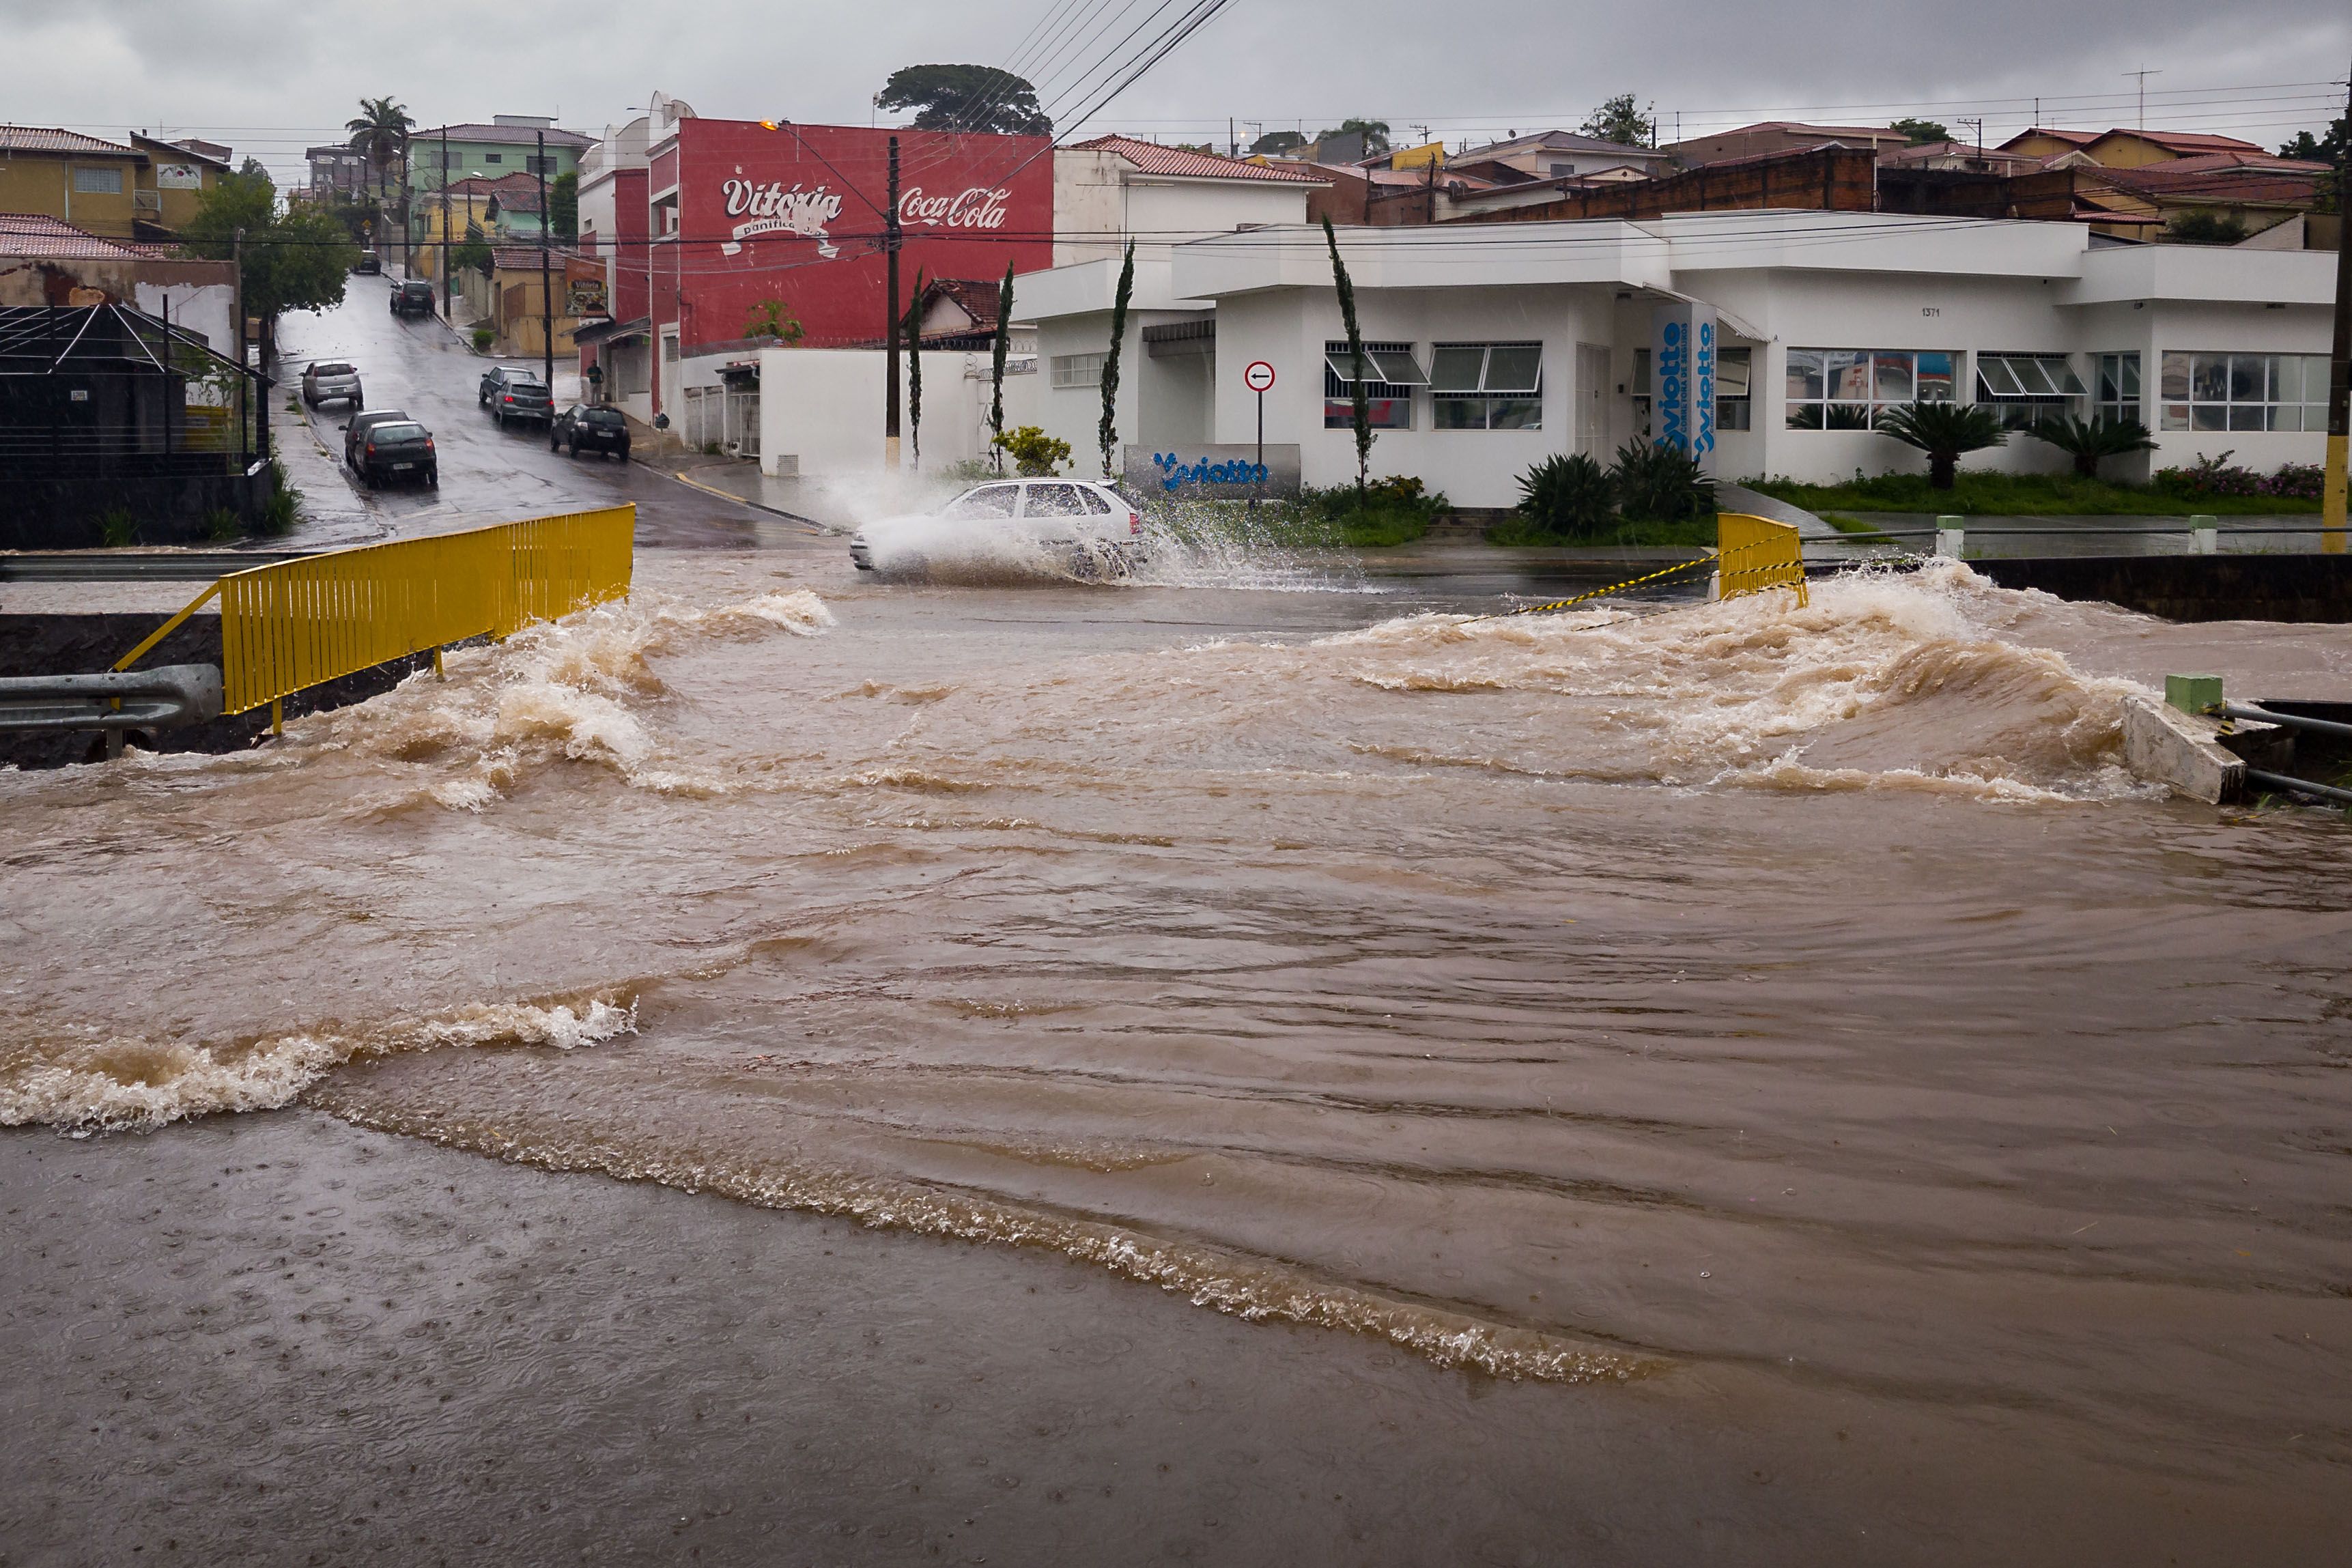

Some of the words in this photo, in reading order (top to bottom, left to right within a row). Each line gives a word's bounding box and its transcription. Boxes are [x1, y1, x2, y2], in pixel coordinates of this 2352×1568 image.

[722, 180, 842, 219] Vitória
[898, 187, 1012, 229] Coca-Cola
[1923, 308, 1939, 317] 1371
[1658, 322, 1680, 433] viotto
[1681, 367, 1688, 377] DE
[1696, 323, 1710, 433] viotto
[1175, 457, 1268, 484] viotto
